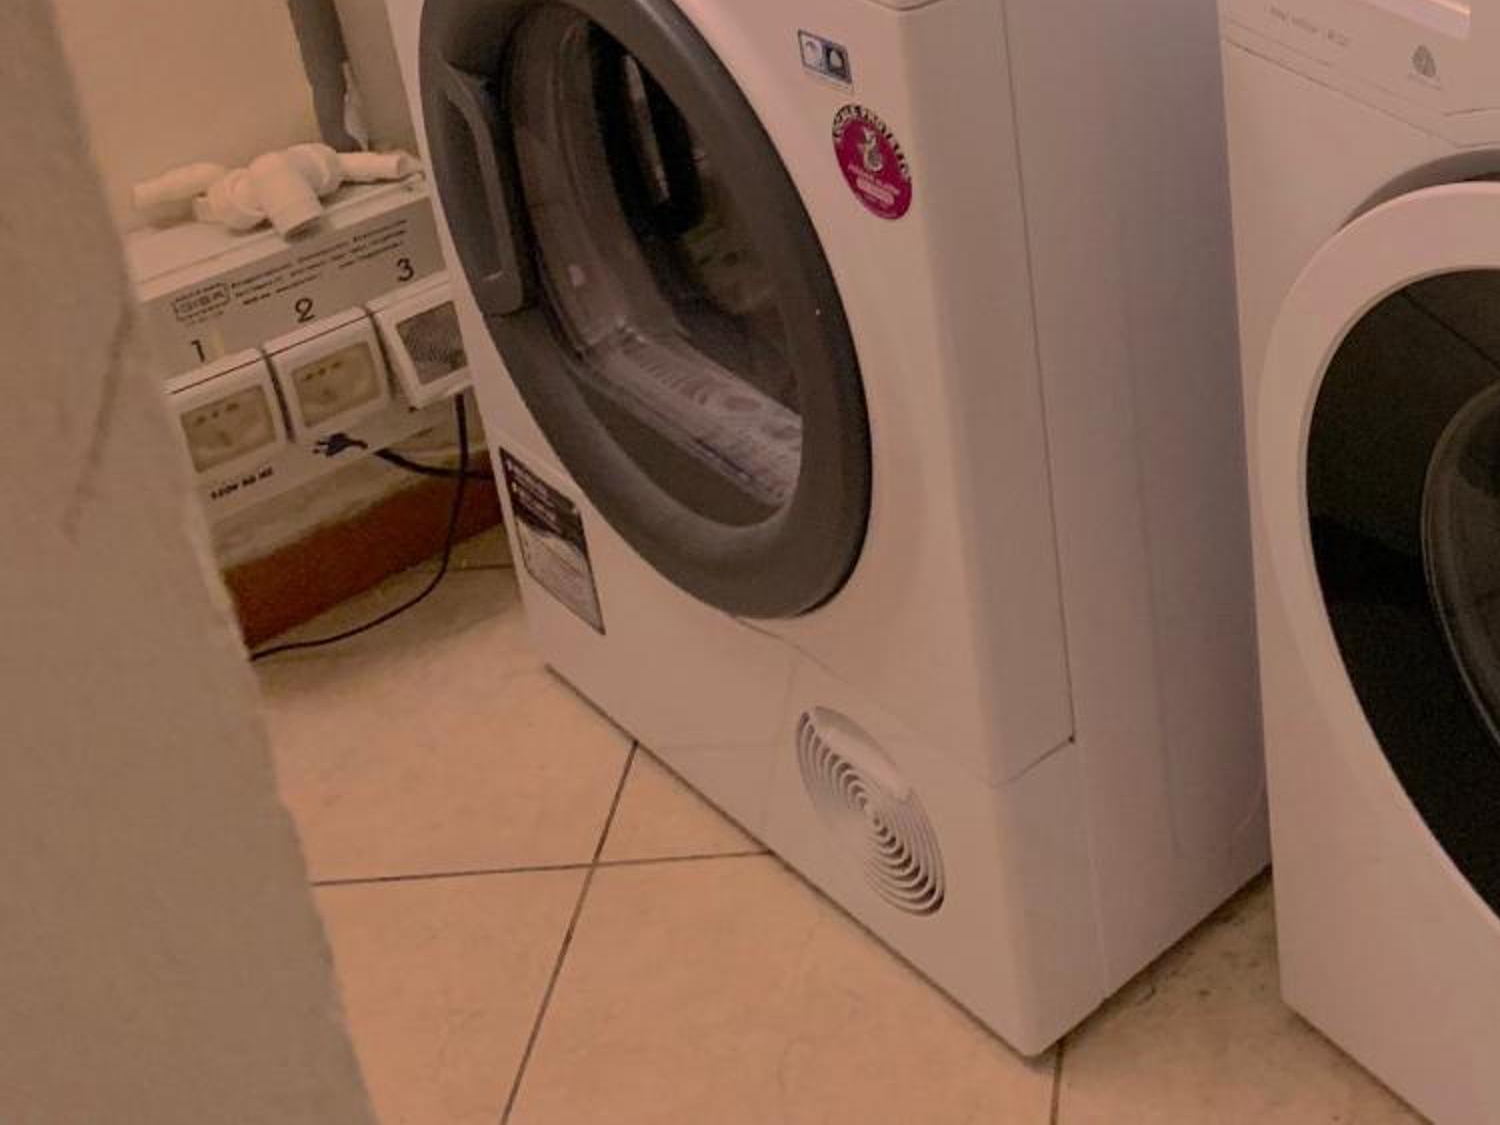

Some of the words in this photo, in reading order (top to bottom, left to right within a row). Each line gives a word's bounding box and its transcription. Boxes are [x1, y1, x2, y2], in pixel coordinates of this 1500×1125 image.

[191, 339, 206, 364] 1
[294, 297, 316, 324] 2
[396, 257, 415, 283] 3
